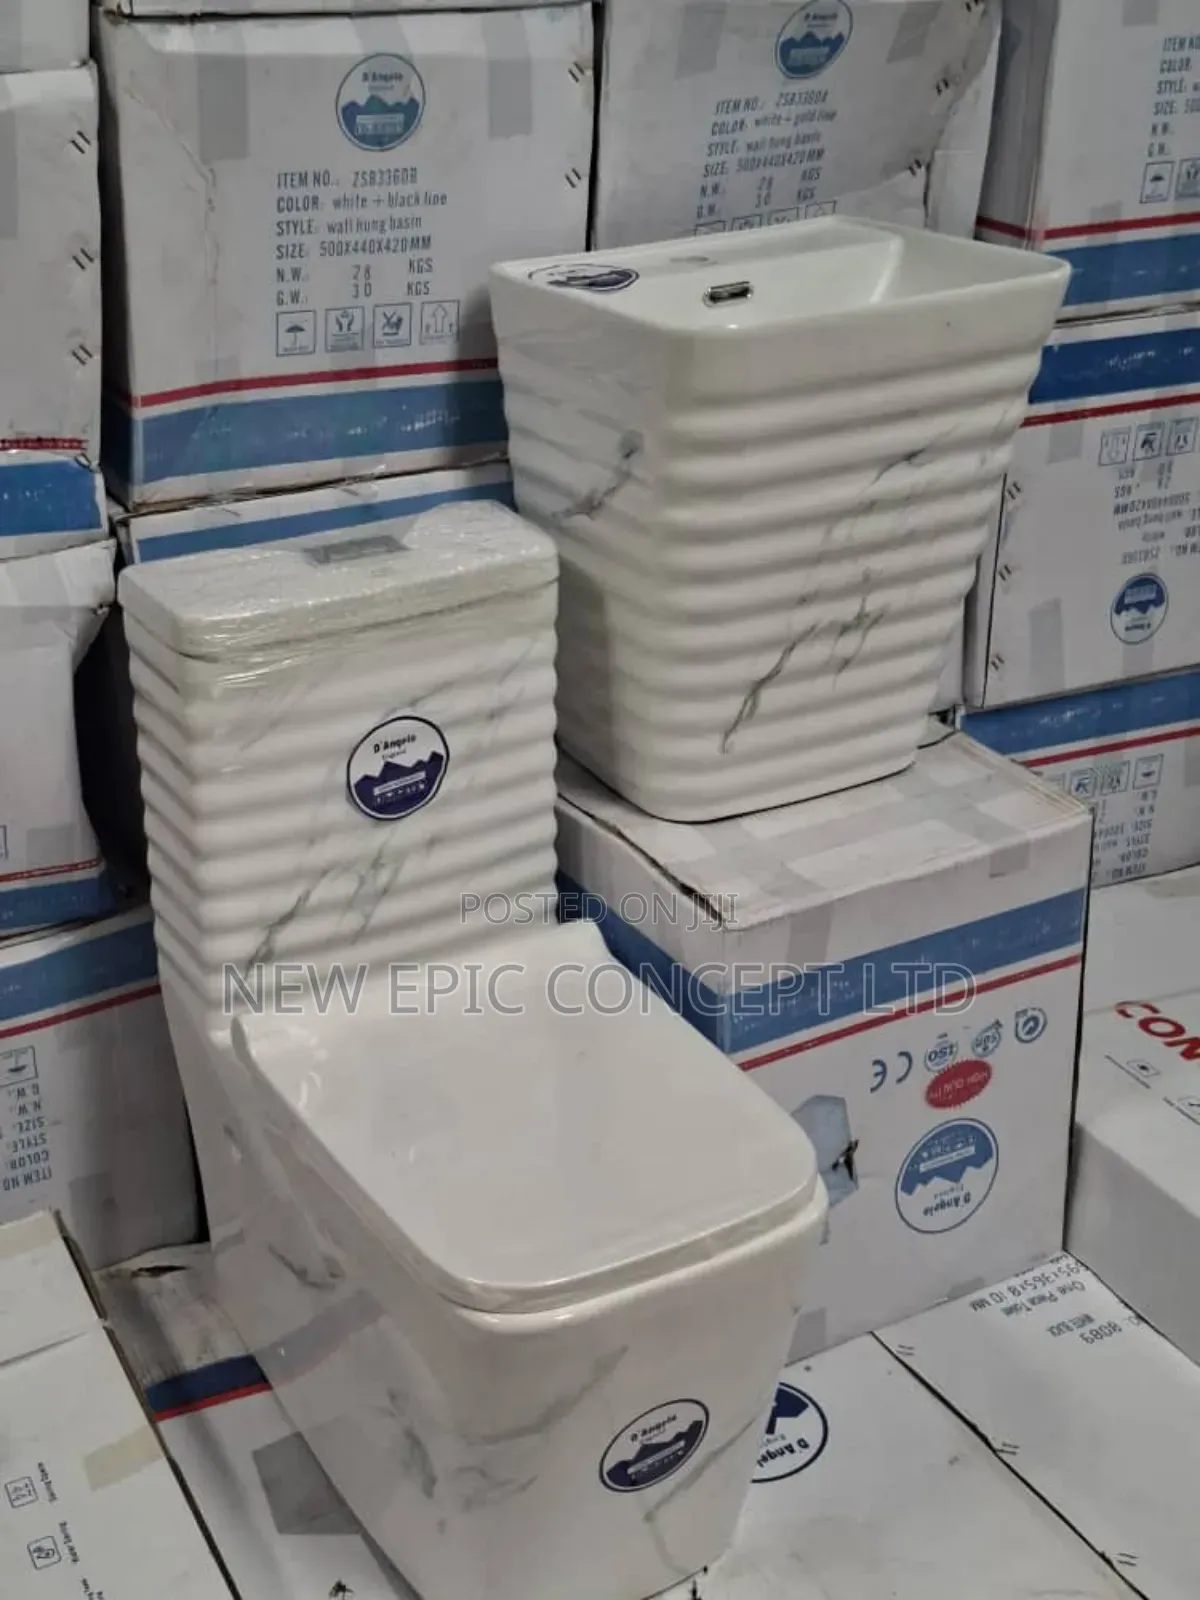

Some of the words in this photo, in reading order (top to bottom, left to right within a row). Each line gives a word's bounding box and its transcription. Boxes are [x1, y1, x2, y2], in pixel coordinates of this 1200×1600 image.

[277, 170, 308, 189] ITEM
[332, 192, 368, 210] white
[388, 192, 420, 208] black
[424, 191, 447, 206] line
[327, 216, 352, 234] wall
[356, 216, 387, 234] hung
[389, 215, 422, 230] basin
[408, 257, 433, 274] KGS
[406, 281, 430, 296] KGS
[928, 1044, 955, 1061] ISO
[23, 1167, 52, 1186] ITEM
